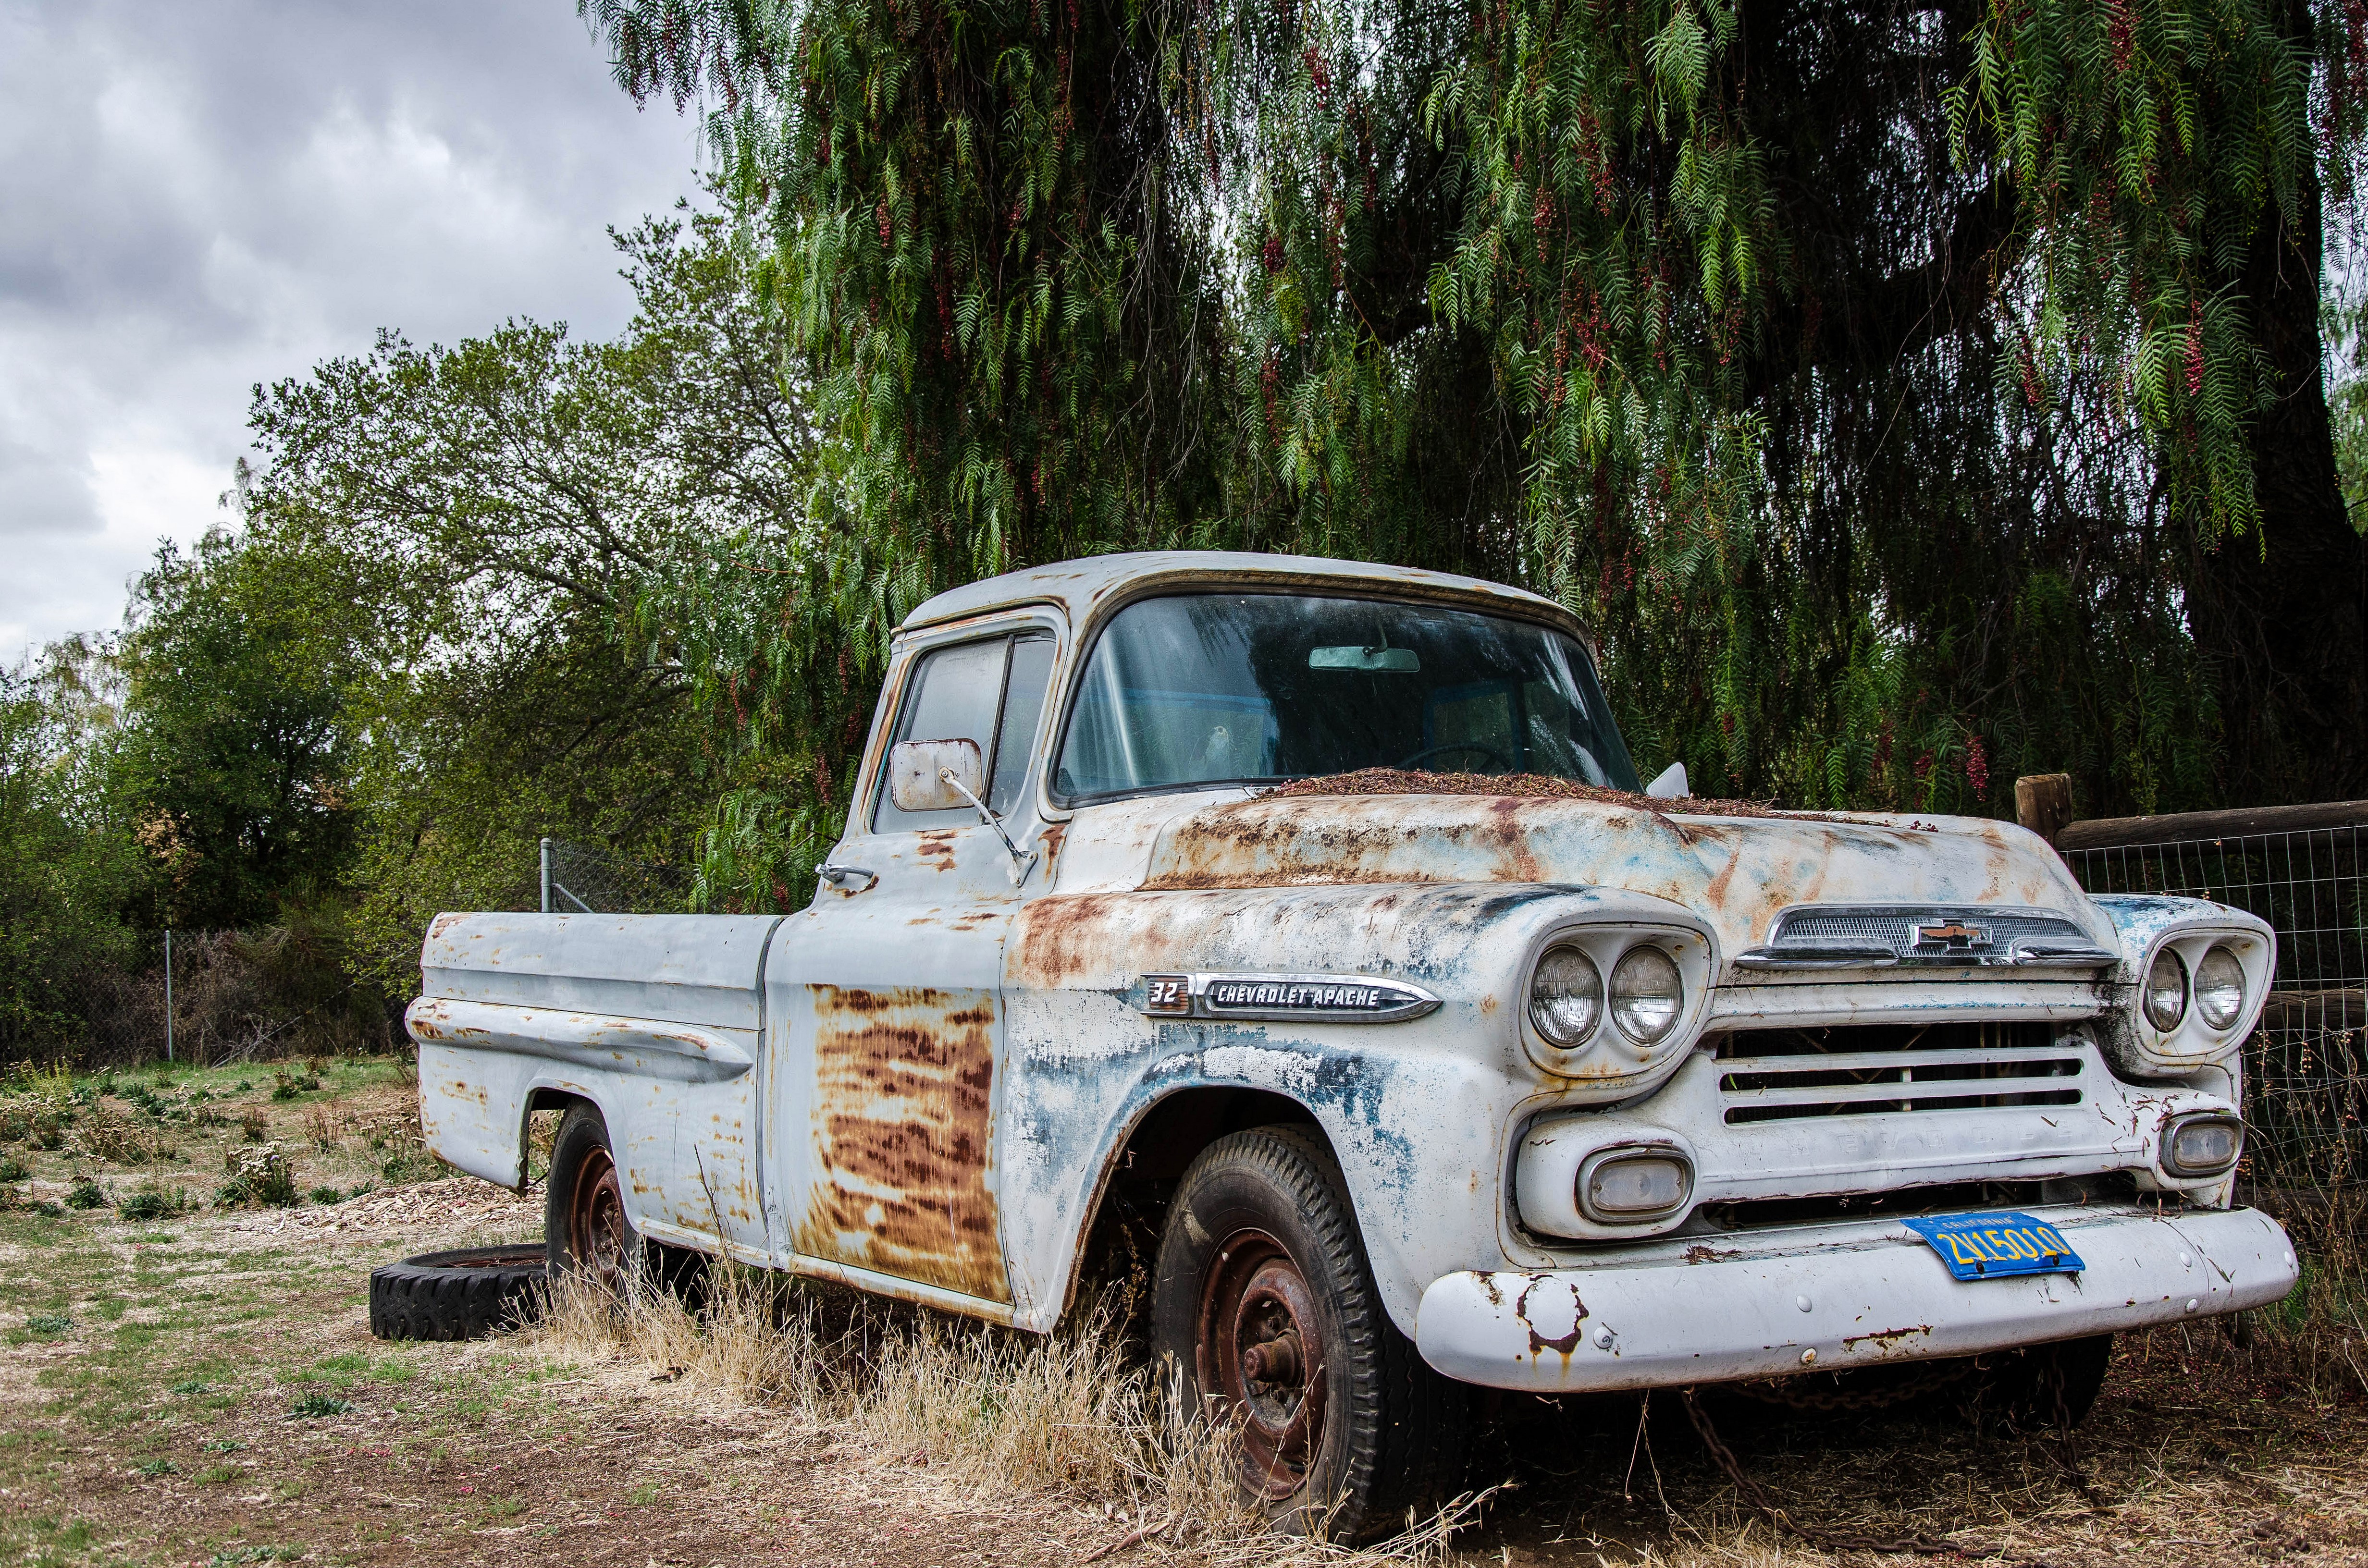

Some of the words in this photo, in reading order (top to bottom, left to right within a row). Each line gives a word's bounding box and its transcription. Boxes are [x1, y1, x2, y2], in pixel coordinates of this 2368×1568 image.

[1150, 982, 1178, 1003] 32
[1218, 985, 1308, 1004] CHEVROLET
[1312, 989, 1380, 1005] APACHE
[1937, 1227, 2071, 1264] 2V15010
